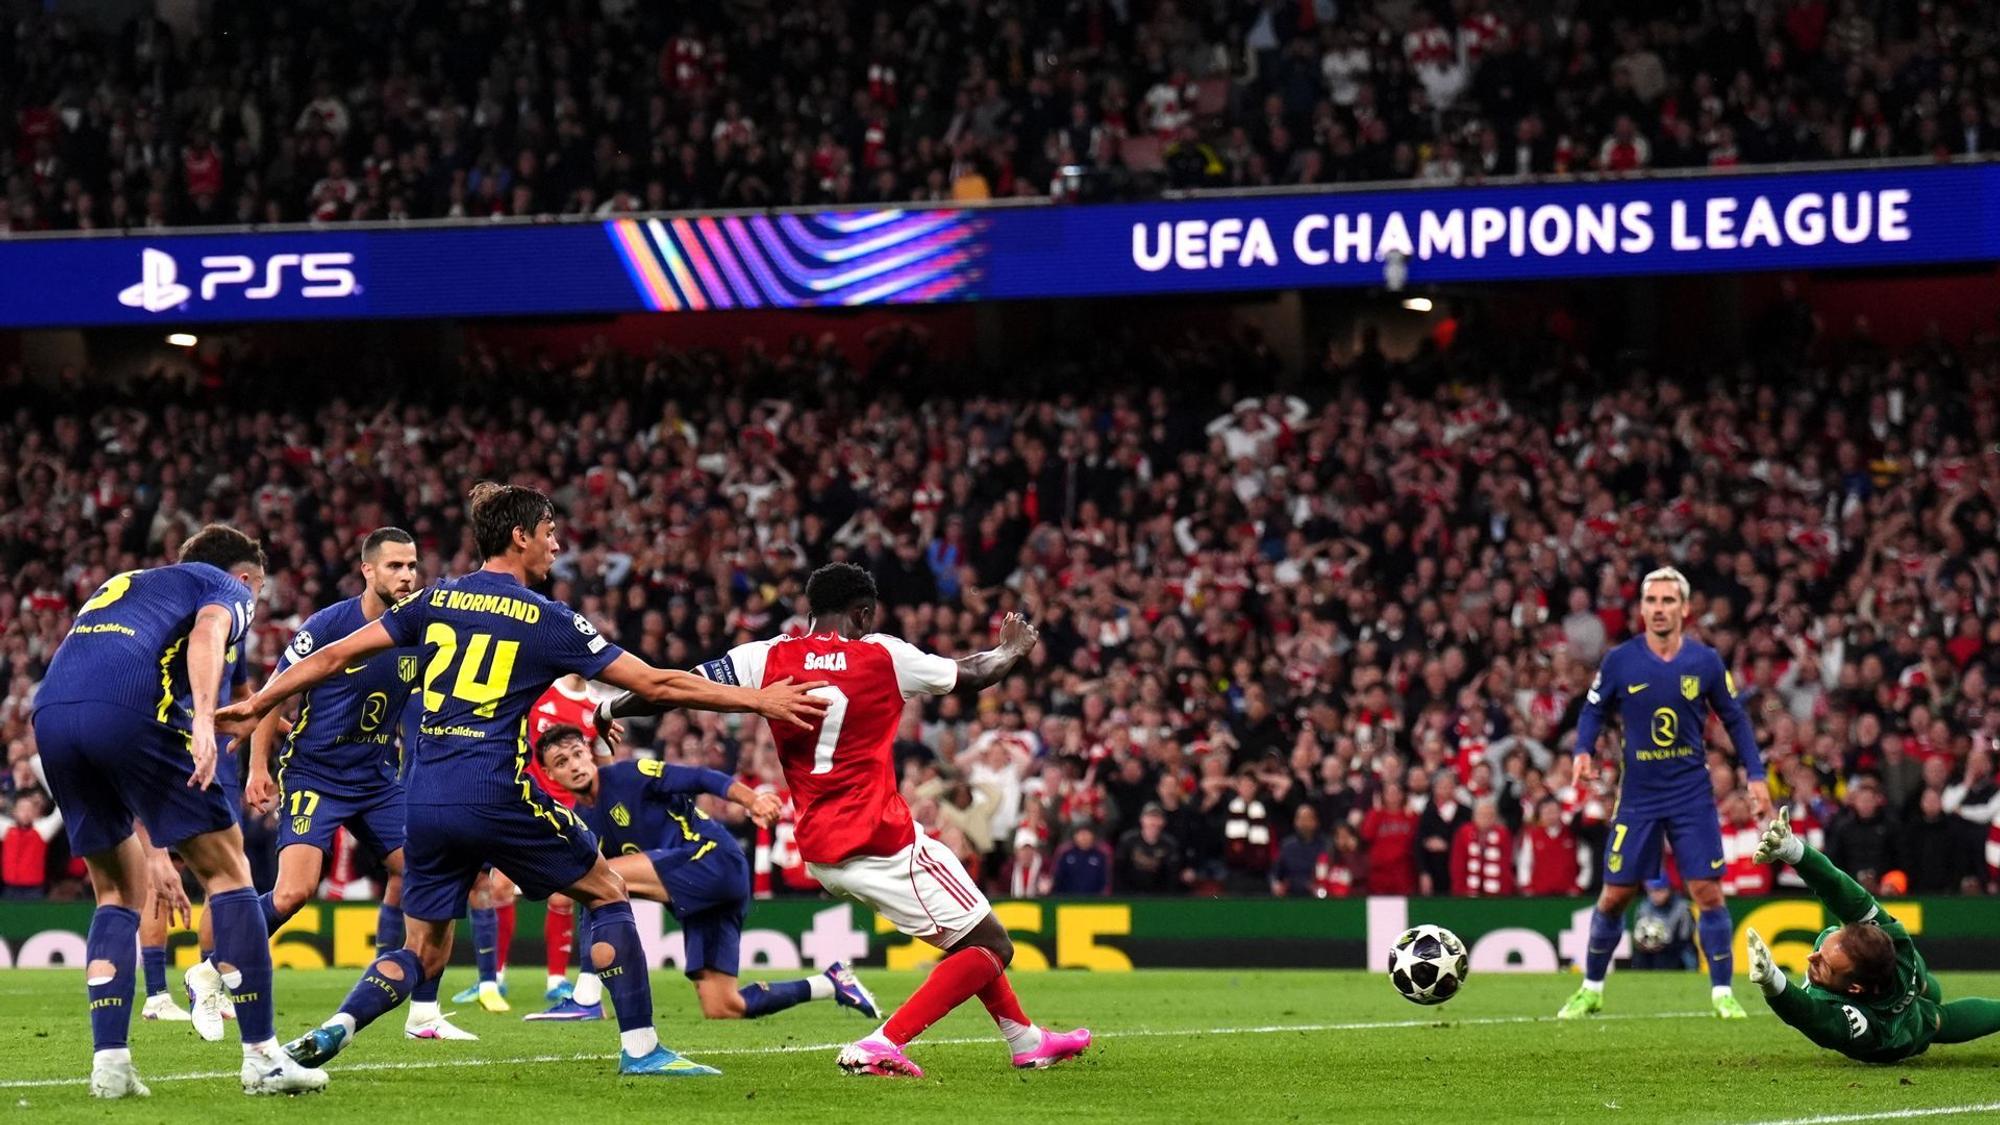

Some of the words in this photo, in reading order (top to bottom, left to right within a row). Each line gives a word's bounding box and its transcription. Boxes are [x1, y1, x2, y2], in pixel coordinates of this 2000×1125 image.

[1132, 217, 1278, 272] UEFA
[1292, 201, 1654, 266] CHAMPIONS
[1670, 188, 1912, 252] LEAGUE
[201, 252, 356, 300] PS5
[430, 589, 448, 607] LE
[446, 590, 541, 625] NORMAND
[93, 623, 136, 637] Children
[423, 622, 520, 718] 24
[803, 651, 847, 672] SAKA
[445, 726, 486, 738] Children
[806, 685, 849, 775] 7
[290, 790, 320, 816] 17
[599, 966, 624, 979] TLETI
[231, 992, 258, 1004] TLETI
[364, 976, 398, 1003] ATLETI
